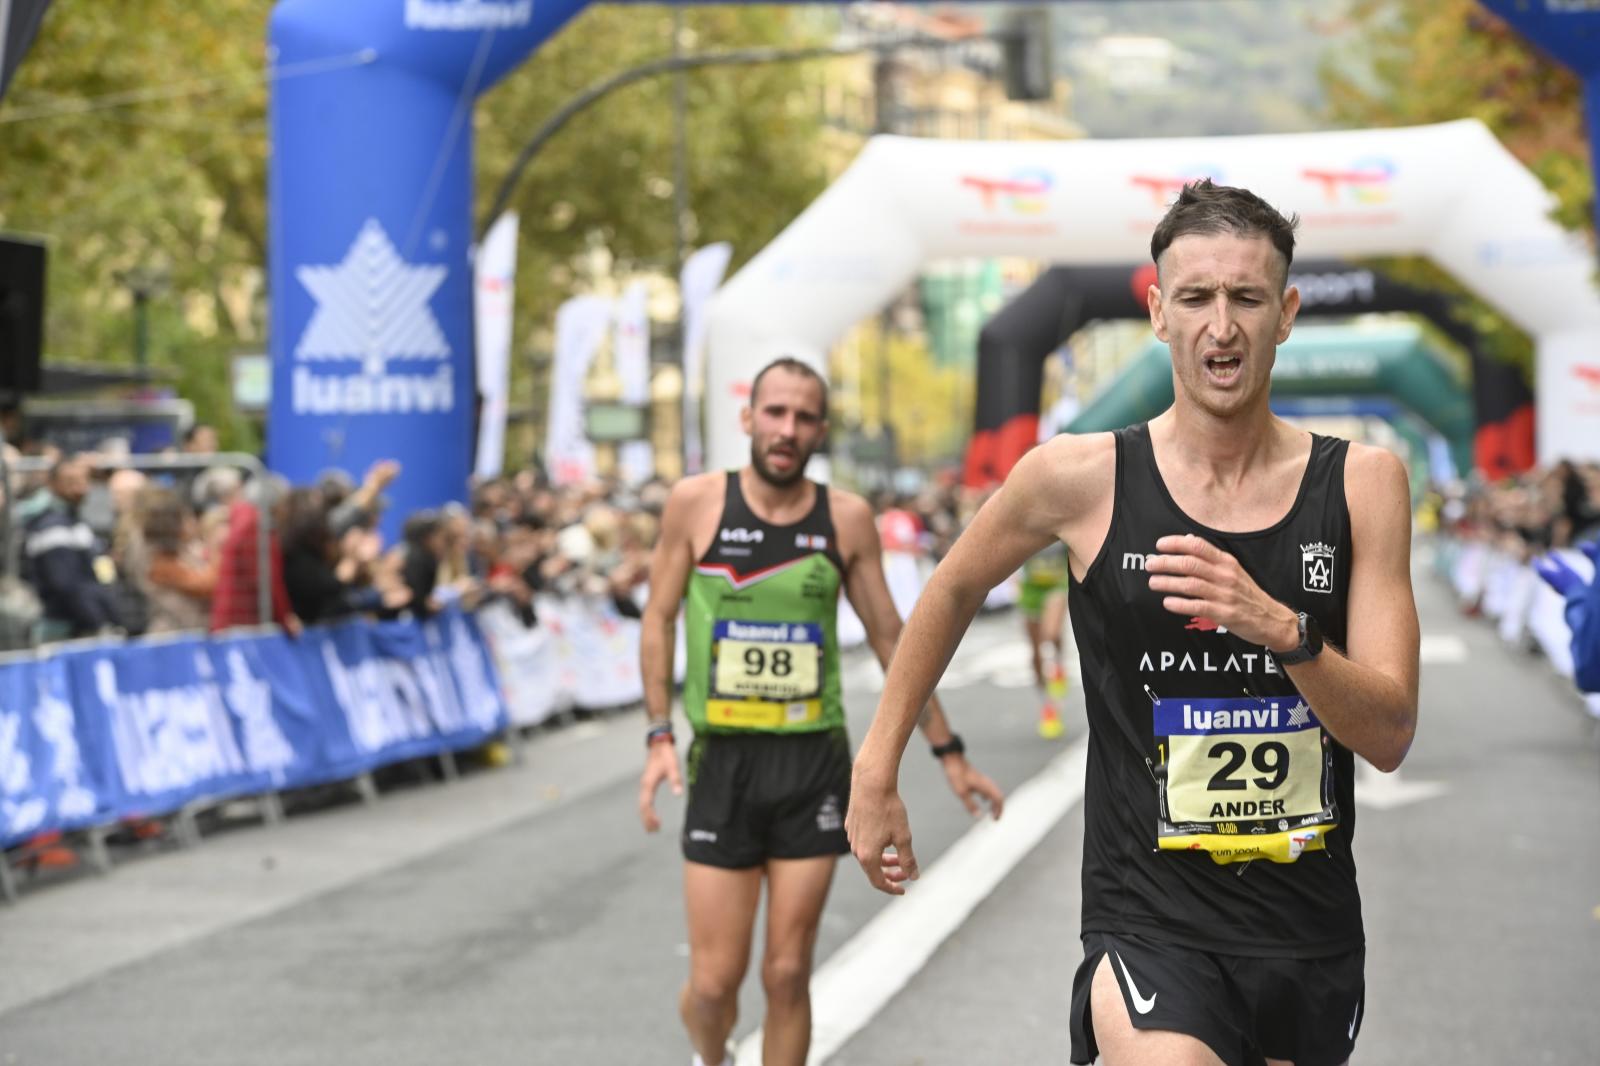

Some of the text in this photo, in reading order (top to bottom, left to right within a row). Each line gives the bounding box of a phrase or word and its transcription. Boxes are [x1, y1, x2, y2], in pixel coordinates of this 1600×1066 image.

[292, 363, 454, 414] luanvi
[744, 647, 792, 677] 98
[1183, 703, 1279, 730] luanvi
[1207, 741, 1290, 791] 29
[1209, 799, 1286, 818] ANDER
